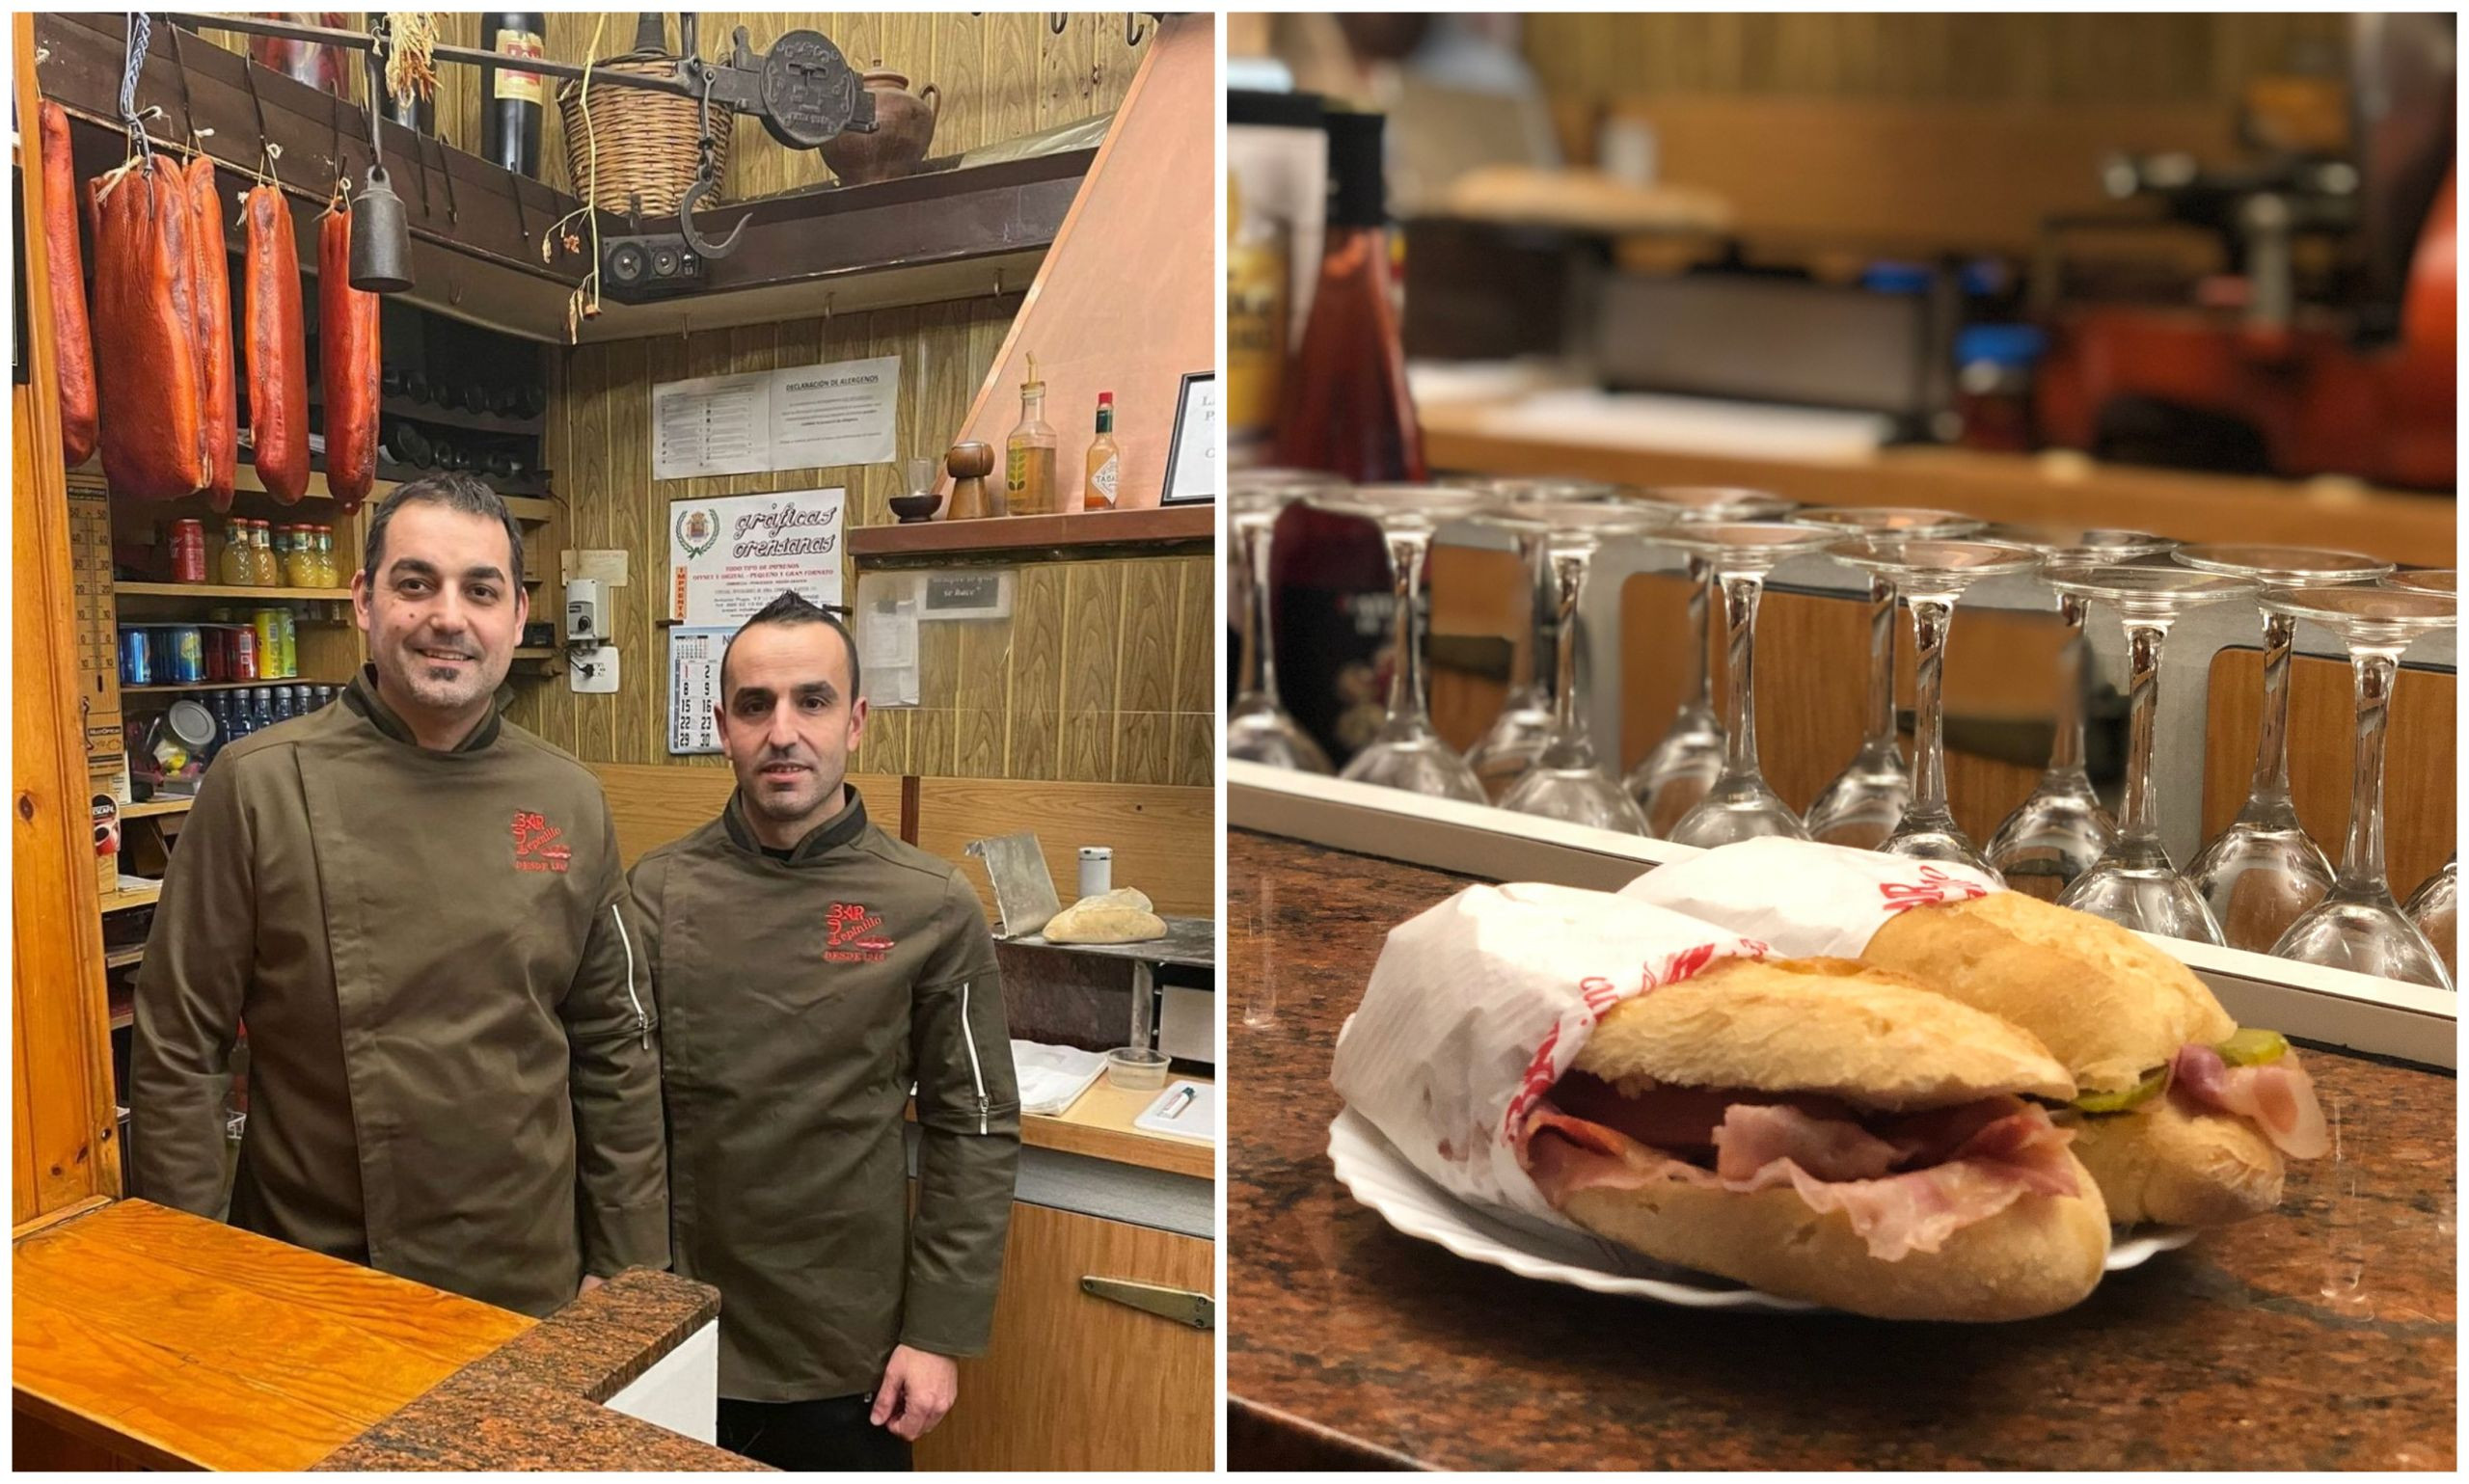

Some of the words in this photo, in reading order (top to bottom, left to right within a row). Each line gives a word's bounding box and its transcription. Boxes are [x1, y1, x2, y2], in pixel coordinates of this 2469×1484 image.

[733, 534, 836, 558] orensanas
[677, 567, 686, 618] IMPRENTA
[704, 665, 710, 679] 2
[684, 682, 690, 695] 8
[704, 682, 710, 695] 9
[681, 699, 691, 713] 15
[702, 699, 712, 713] 16
[680, 716, 691, 730] 22
[701, 716, 712, 730] 23
[680, 733, 690, 746] 29
[700, 733, 711, 746] 30
[511, 813, 545, 830] BAR
[826, 904, 865, 920] BAR
[825, 951, 862, 961] DESDE
